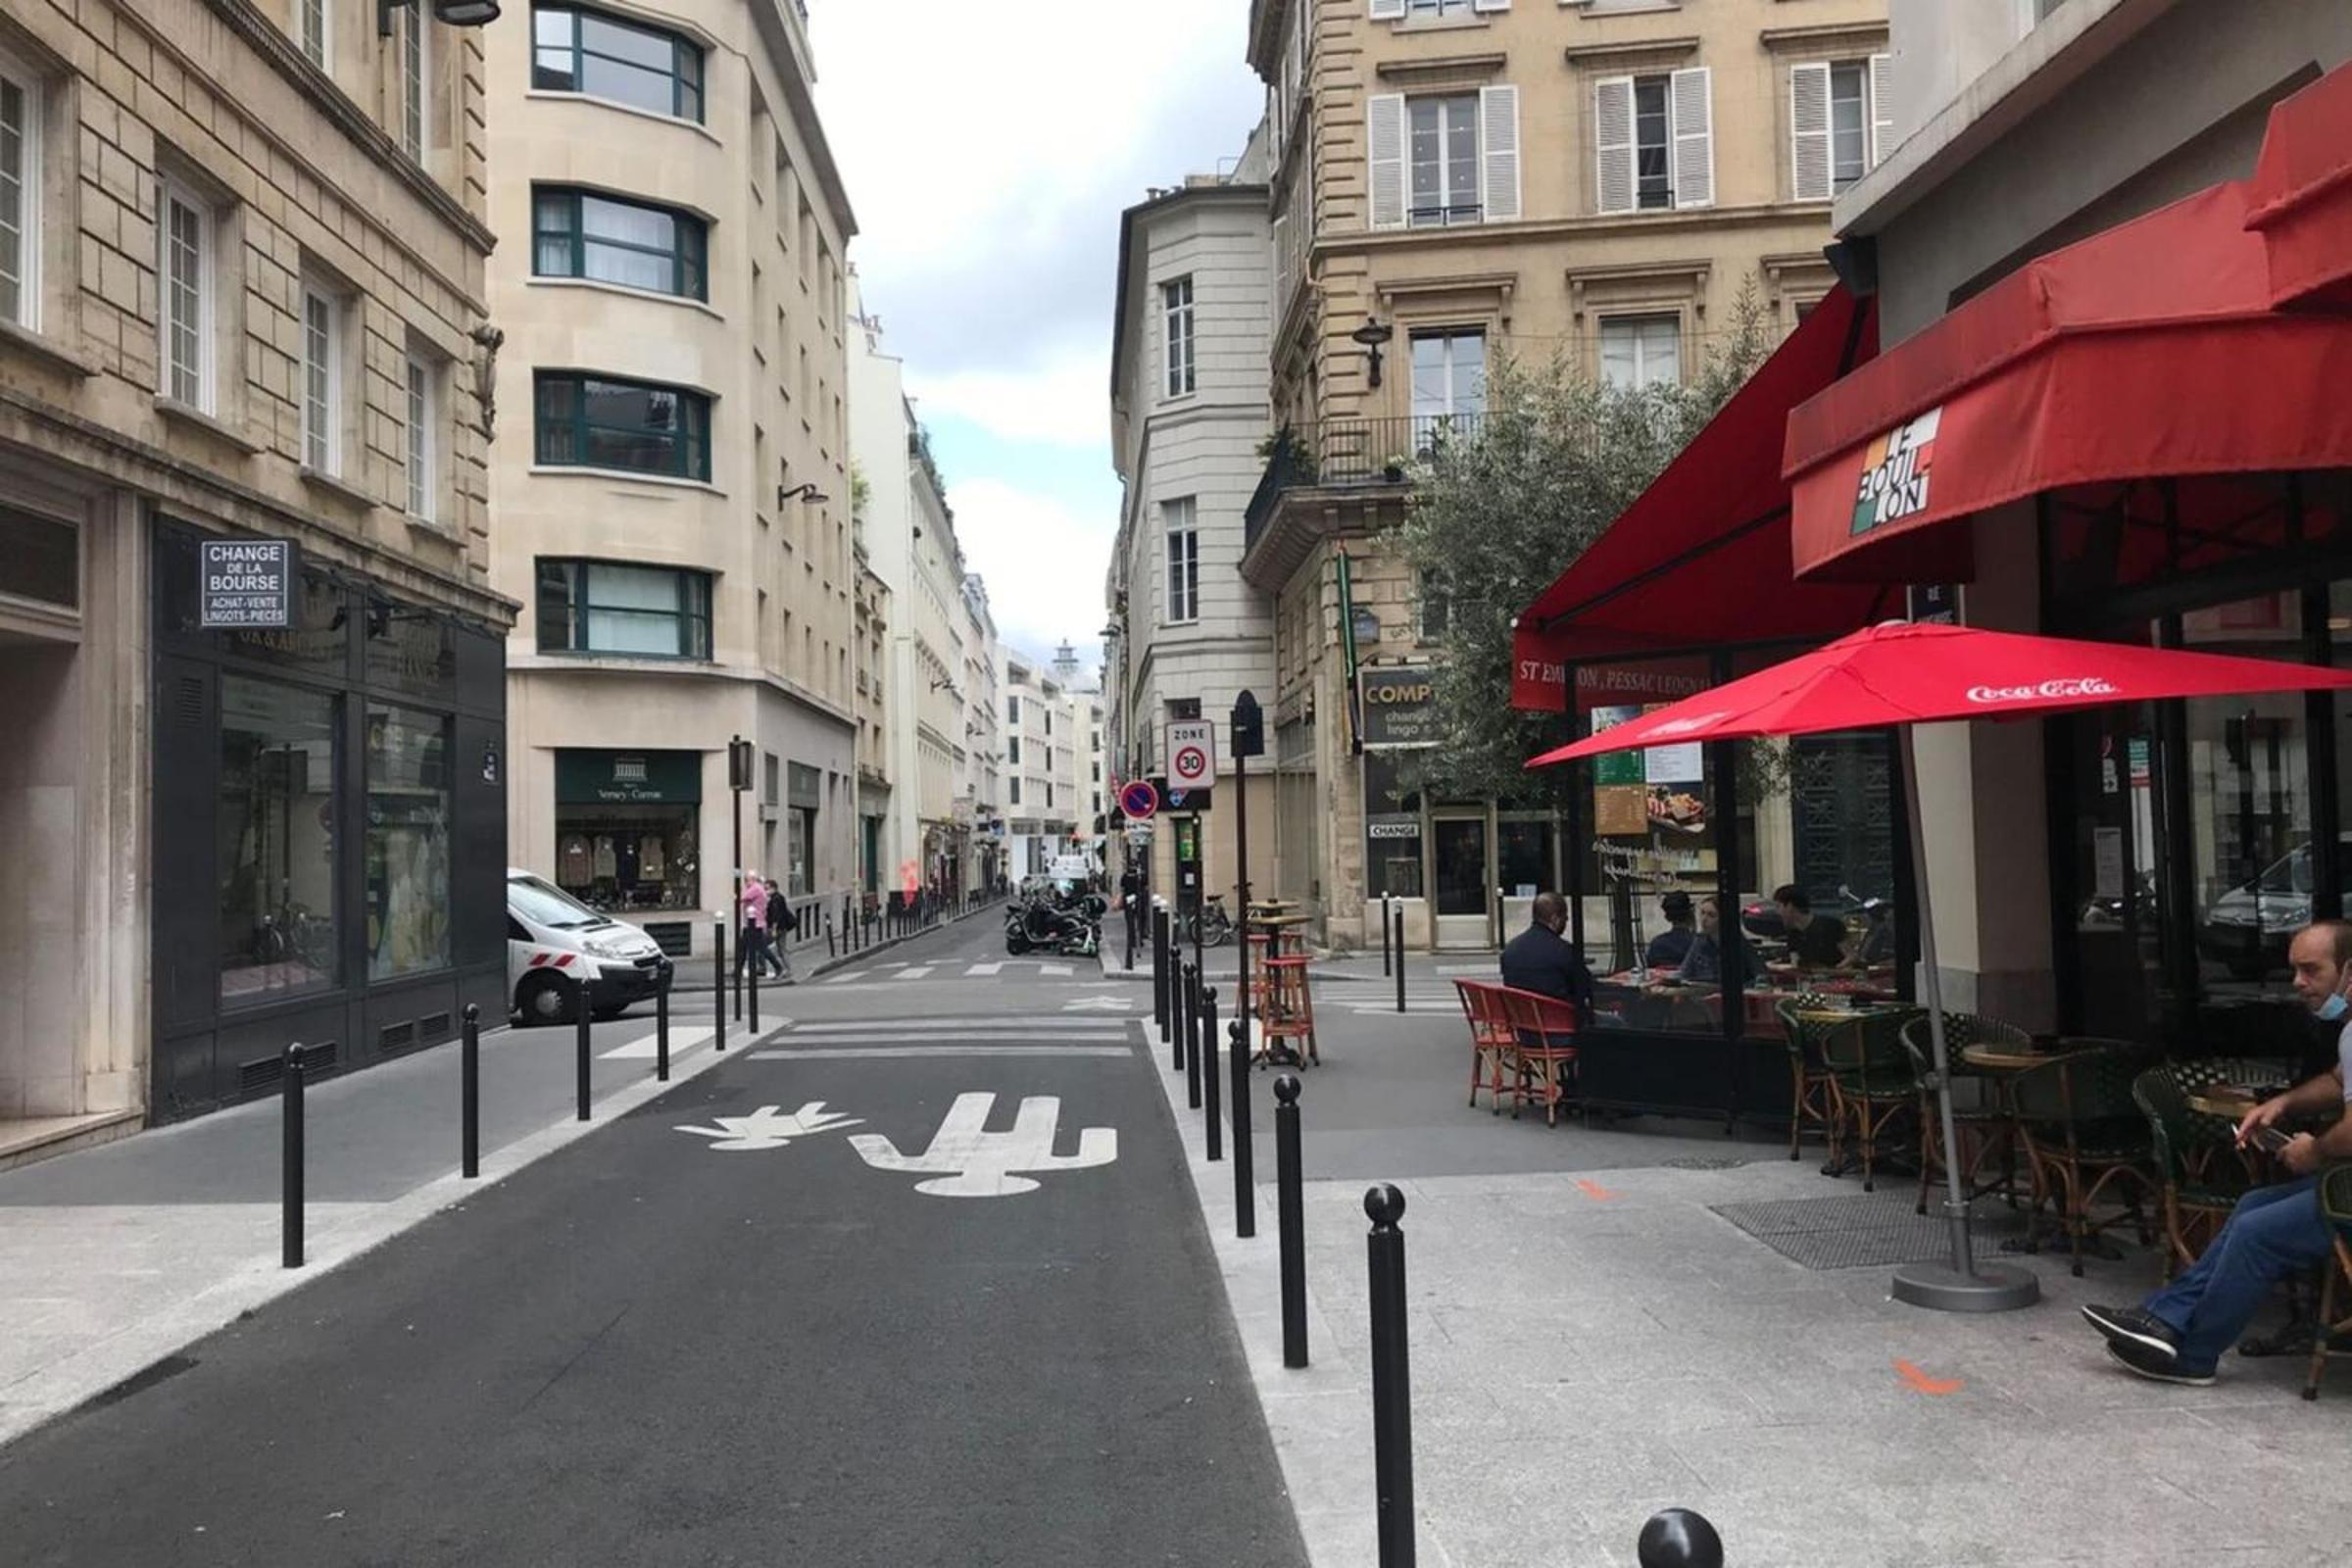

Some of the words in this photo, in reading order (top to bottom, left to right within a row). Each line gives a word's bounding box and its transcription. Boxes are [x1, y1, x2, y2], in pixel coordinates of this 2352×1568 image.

[209, 546, 281, 562] CHANGE
[226, 563, 243, 574] DE
[245, 563, 263, 574] LA
[210, 575, 279, 591] BOURSE
[1519, 660, 1539, 681] ST
[1606, 670, 1655, 692] PESSAC
[1174, 728, 1204, 741] ZONE
[1182, 755, 1200, 770] 30
[1373, 826, 1416, 836] CHANGE
